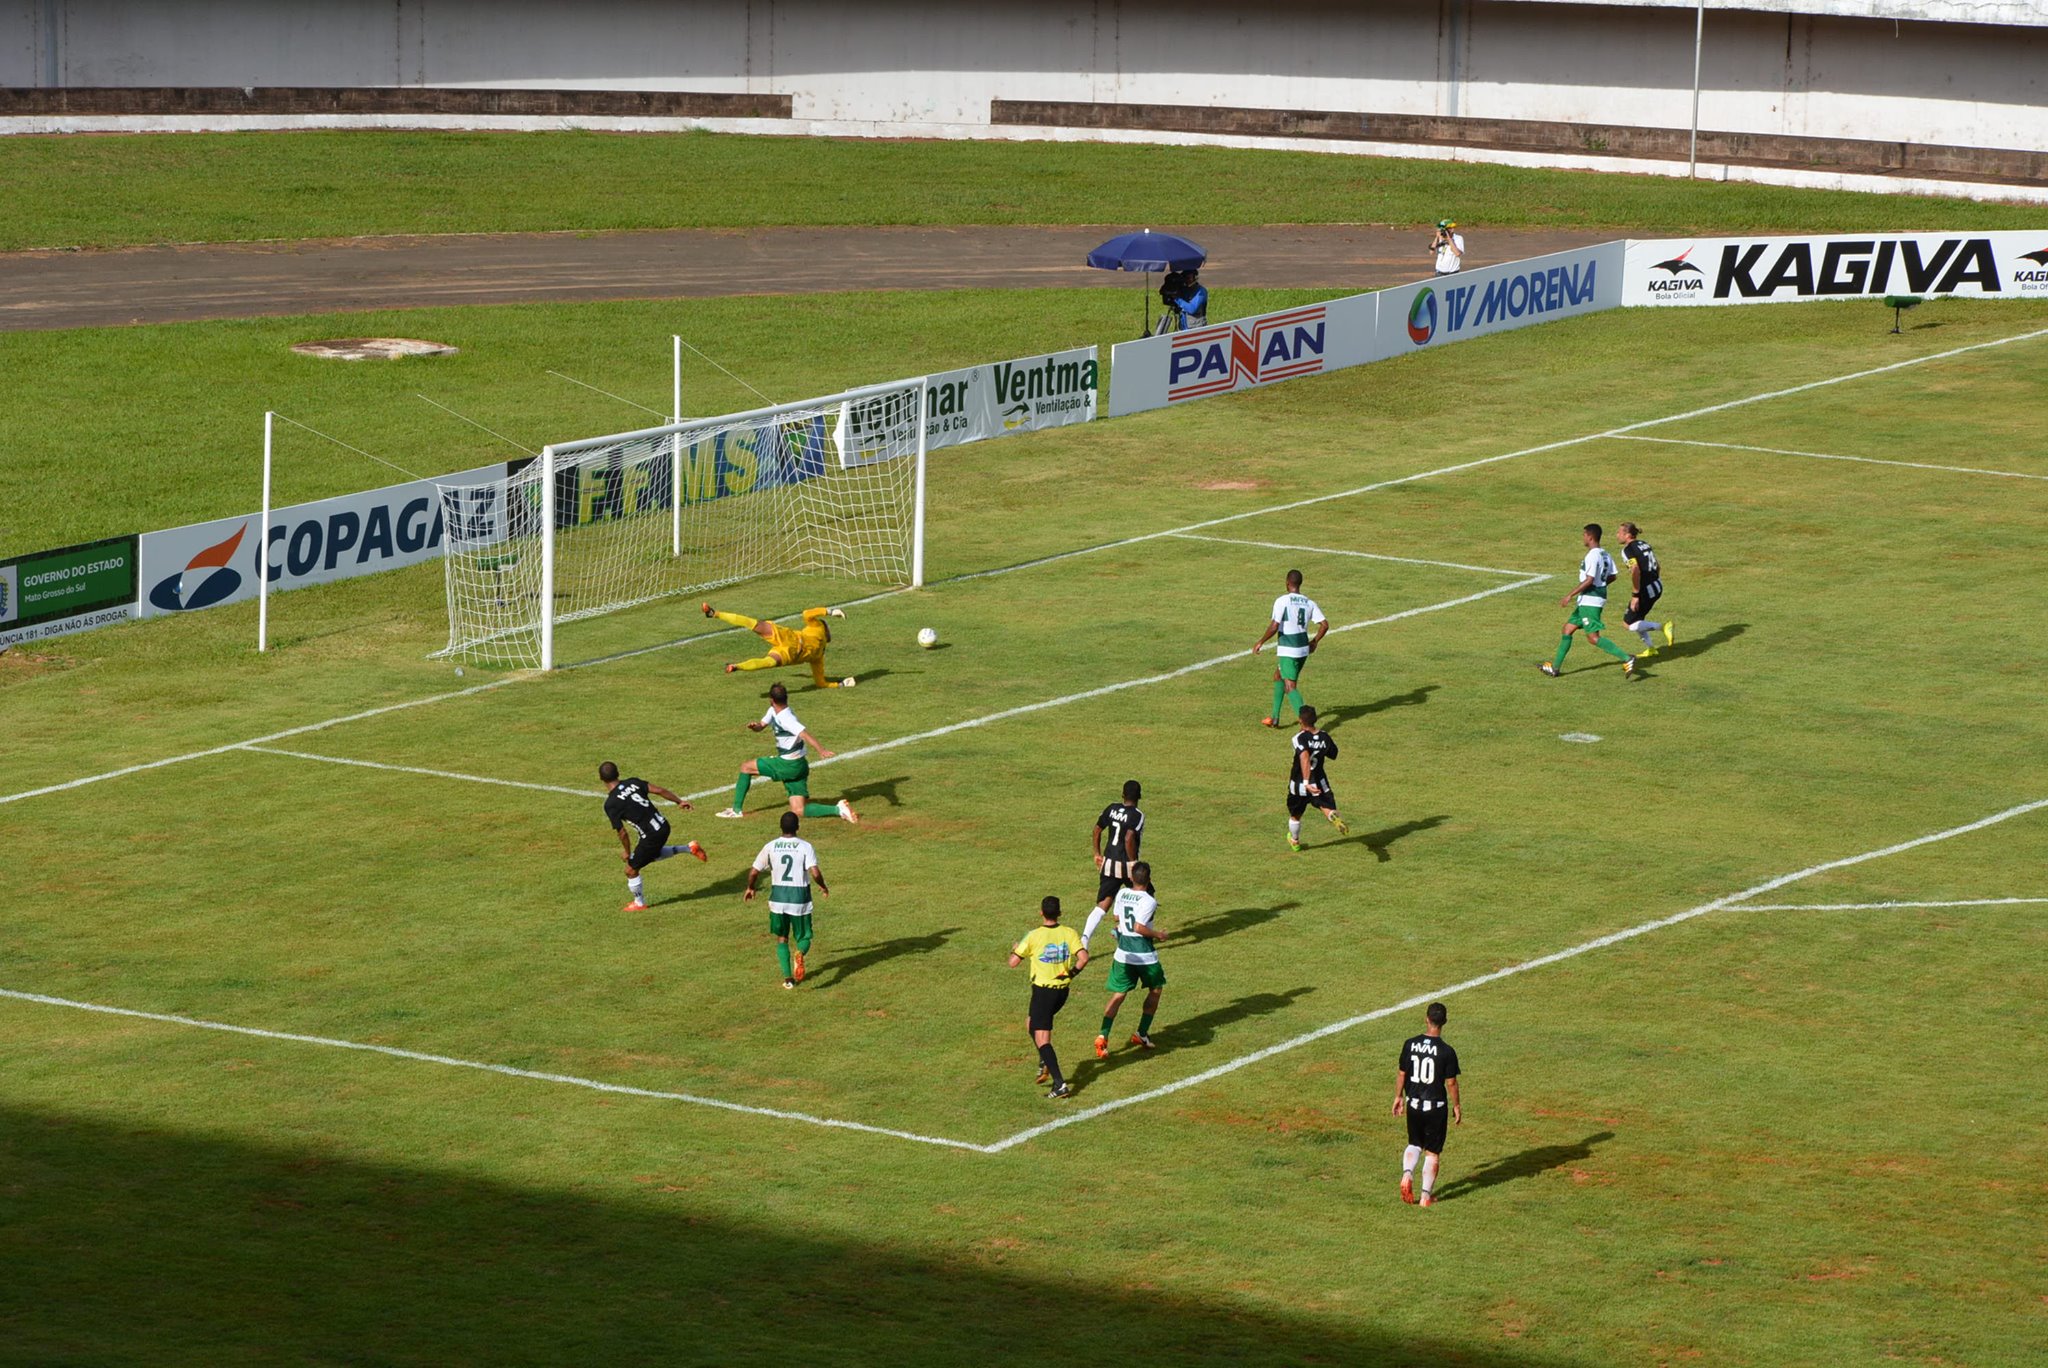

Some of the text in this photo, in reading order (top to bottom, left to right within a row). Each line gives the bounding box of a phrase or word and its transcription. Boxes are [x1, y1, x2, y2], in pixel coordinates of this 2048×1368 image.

[1714, 239, 2001, 298] KAGIVA
[1445, 260, 1596, 333] TV MORENA
[1648, 279, 1703, 291] KAGIVA
[1169, 321, 1326, 385] PANAN
[994, 358, 1097, 405] Ventma
[1035, 396, 1091, 416] Ventilação &
[943, 418, 950, 432] &
[953, 416, 967, 430] Cia
[255, 490, 496, 583] COPAGAZ
[24, 557, 124, 588] GOVERNO DO ESTADO
[25, 582, 86, 602] Mato Grosso do Sul
[26, 630, 38, 640] 181
[45, 625, 64, 636] DIGA
[65, 620, 82, 632] NÃO
[95, 609, 128, 625] DROGAS
[774, 841, 799, 849] MRV
[1112, 821, 1120, 846] 7
[781, 854, 794, 881] 2
[1124, 906, 1136, 932] 5
[1410, 1055, 1435, 1084] 10
